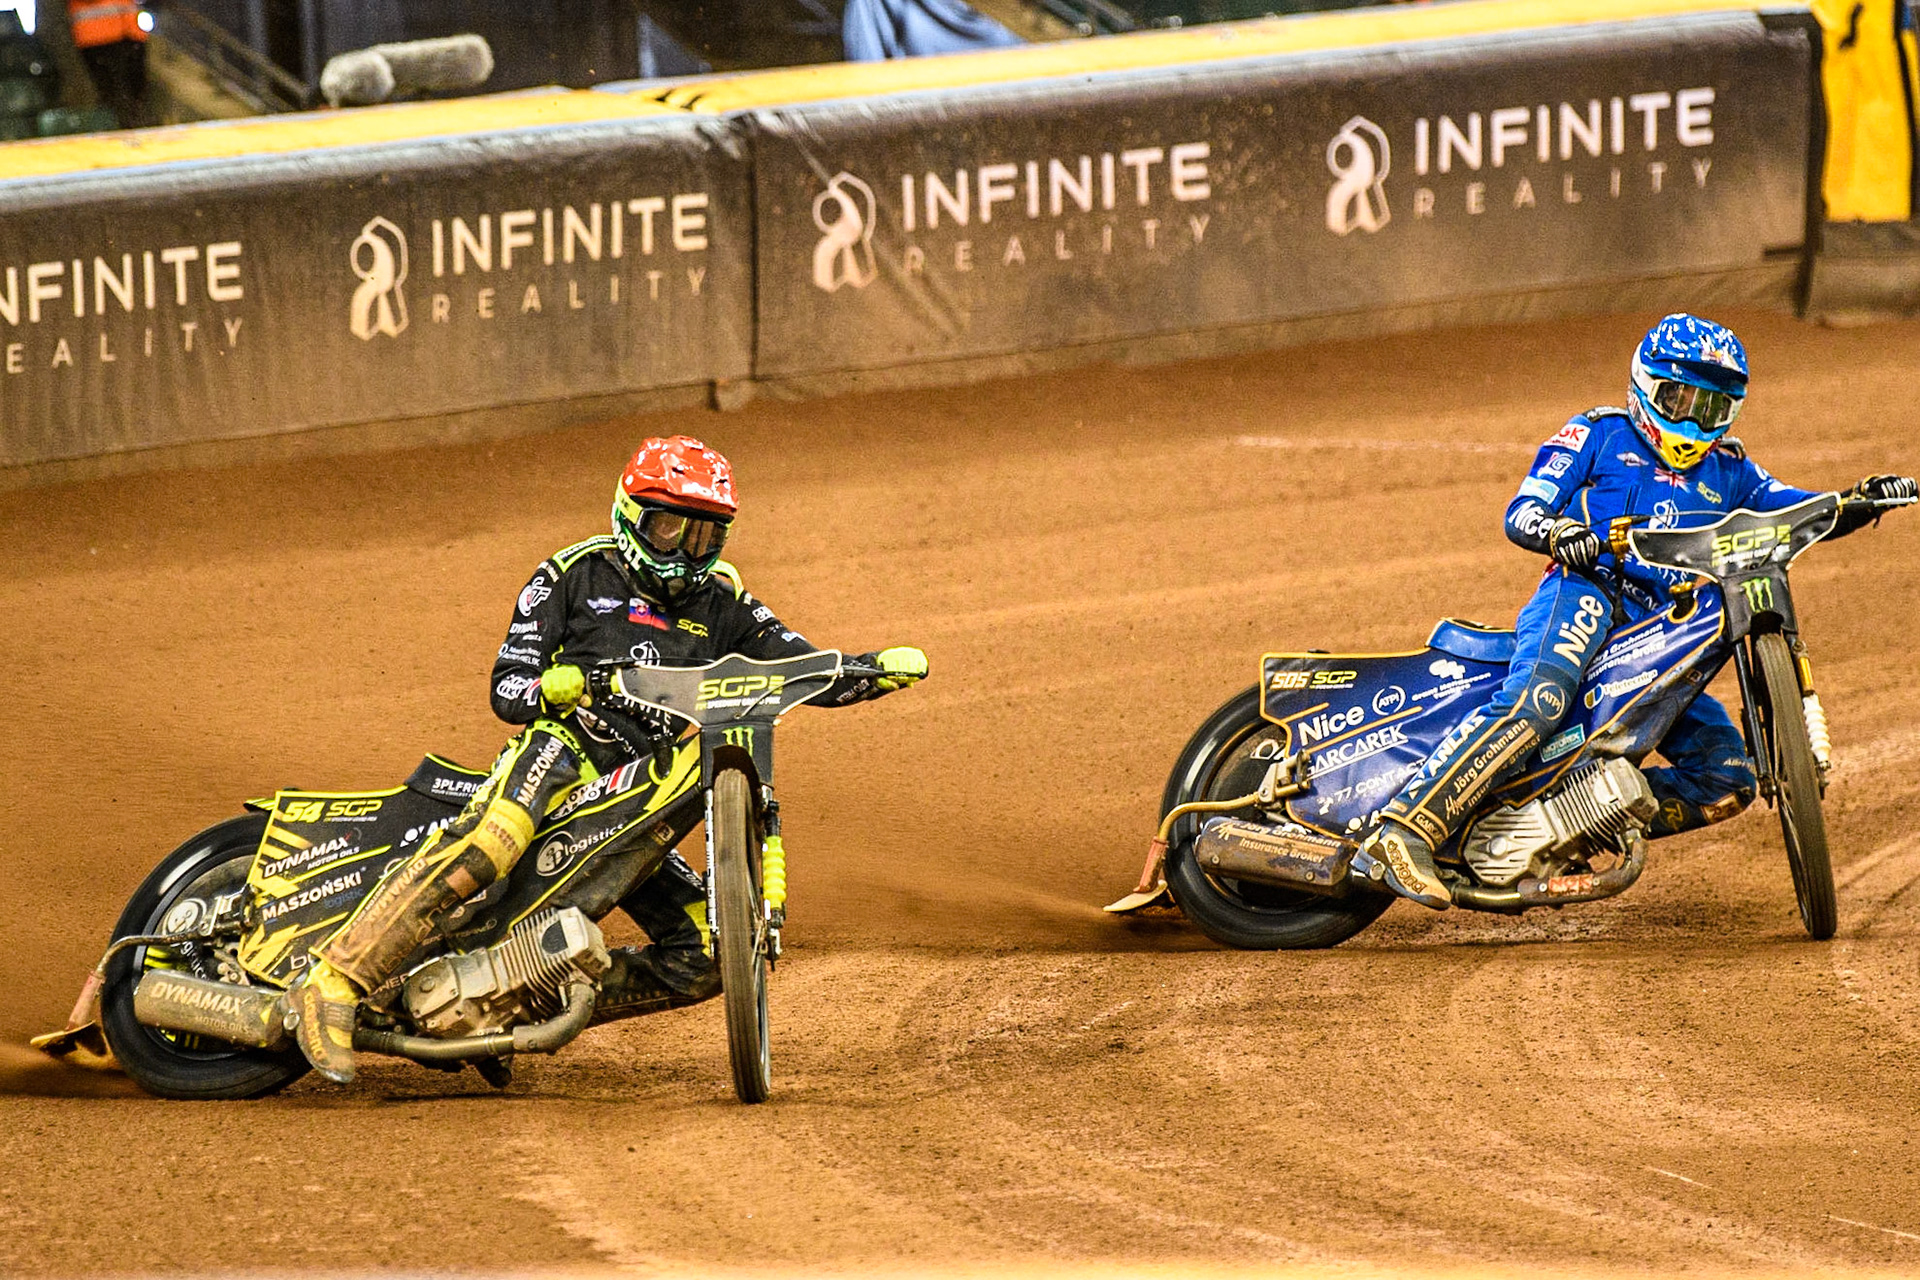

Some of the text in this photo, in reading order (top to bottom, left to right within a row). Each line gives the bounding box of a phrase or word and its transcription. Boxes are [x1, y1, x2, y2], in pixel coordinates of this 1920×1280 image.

[1415, 87, 1715, 175] INFINITE
[902, 142, 1212, 232] INFINITE
[1414, 158, 1712, 219] REALITY
[432, 193, 709, 278] INFINITE
[904, 214, 1211, 274] REALITY
[432, 267, 707, 324] REALITY
[6, 317, 243, 374] EALITY
[1553, 595, 1604, 667] Nice
[1610, 623, 1663, 654] Grohmann
[1311, 671, 1357, 685] SGP
[1378, 693, 1400, 708] ATPI
[1297, 706, 1364, 746] Nice
[1453, 766, 1478, 793] Jörg
[1474, 718, 1528, 770] Grohmann
[282, 800, 383, 823] 54 SGP
[1334, 787, 1352, 802] 77
[264, 837, 348, 878] DYNAMAX
[307, 847, 360, 870] MOTOR OILS
[564, 823, 624, 856] logistics
[1240, 838, 1325, 864] Insurance Broker
[1387, 840, 1428, 894] daytona
[262, 871, 362, 921] MASZOŃSKI
[150, 981, 242, 1016] DYNAMAX
[195, 1015, 227, 1031] MOTOR
